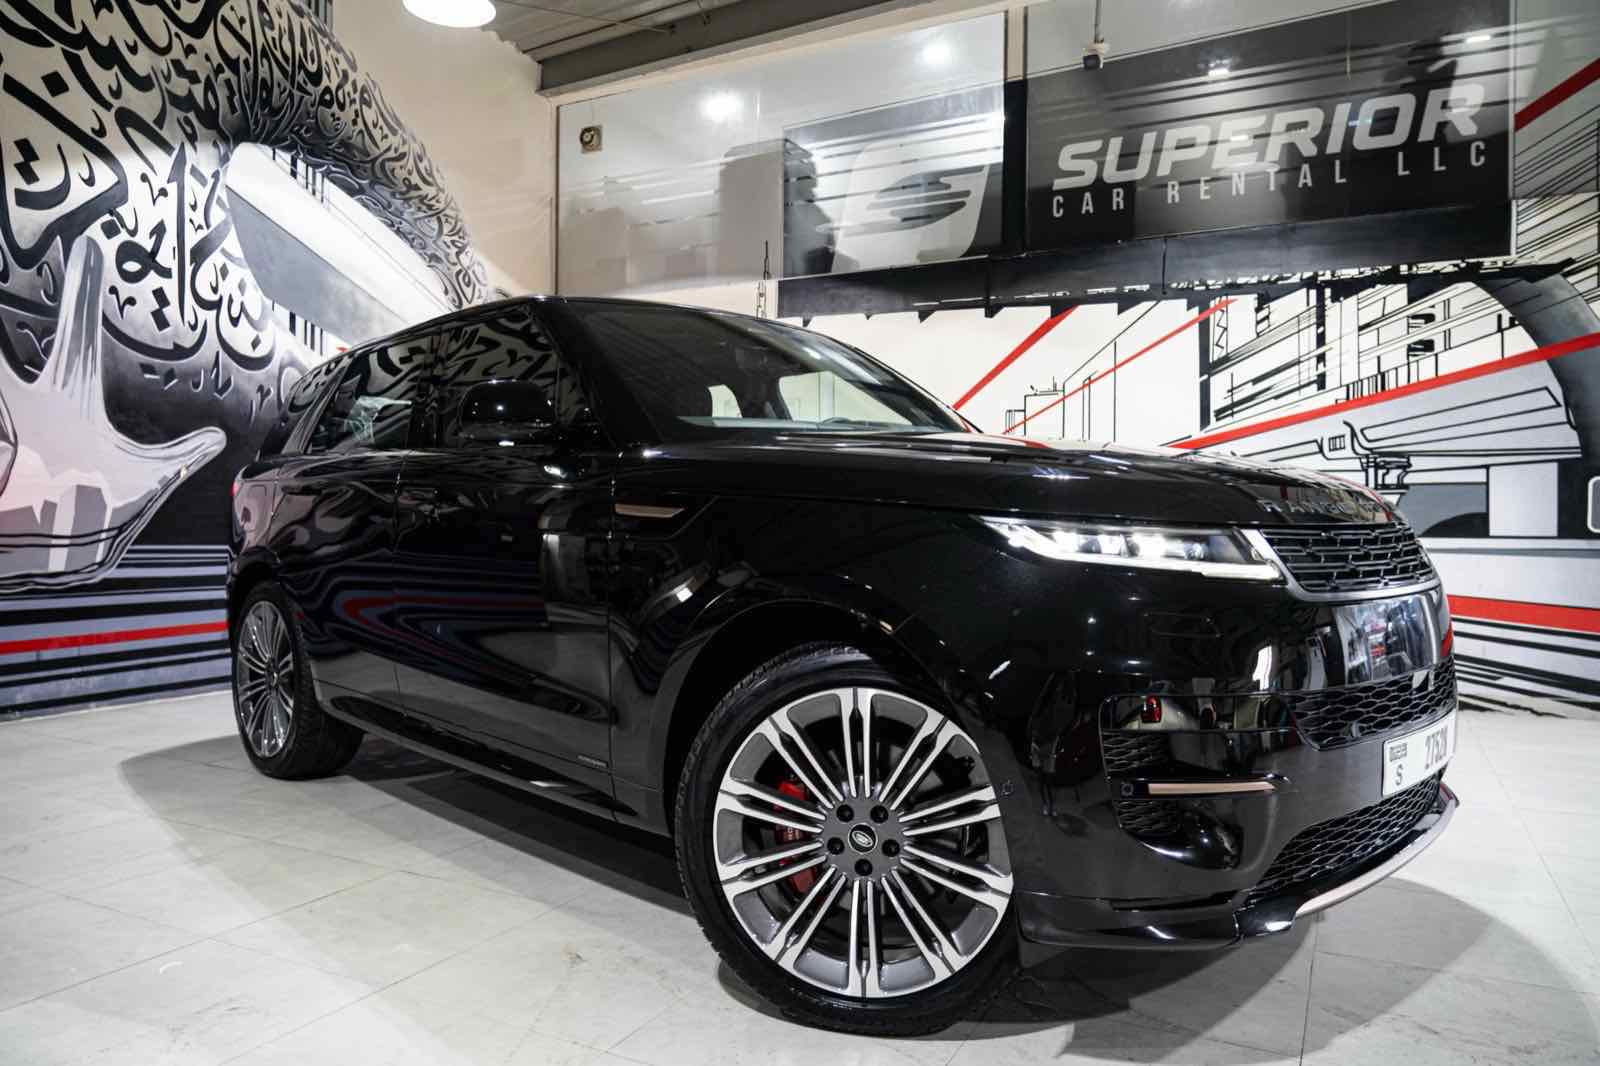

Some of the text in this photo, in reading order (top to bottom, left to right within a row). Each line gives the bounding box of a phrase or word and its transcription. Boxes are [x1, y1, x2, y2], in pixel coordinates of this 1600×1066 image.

[1052, 83, 1485, 191] SUPERIOR
[1052, 140, 1486, 218] CAR RENTAL LLC
[1395, 763, 1404, 786] S
